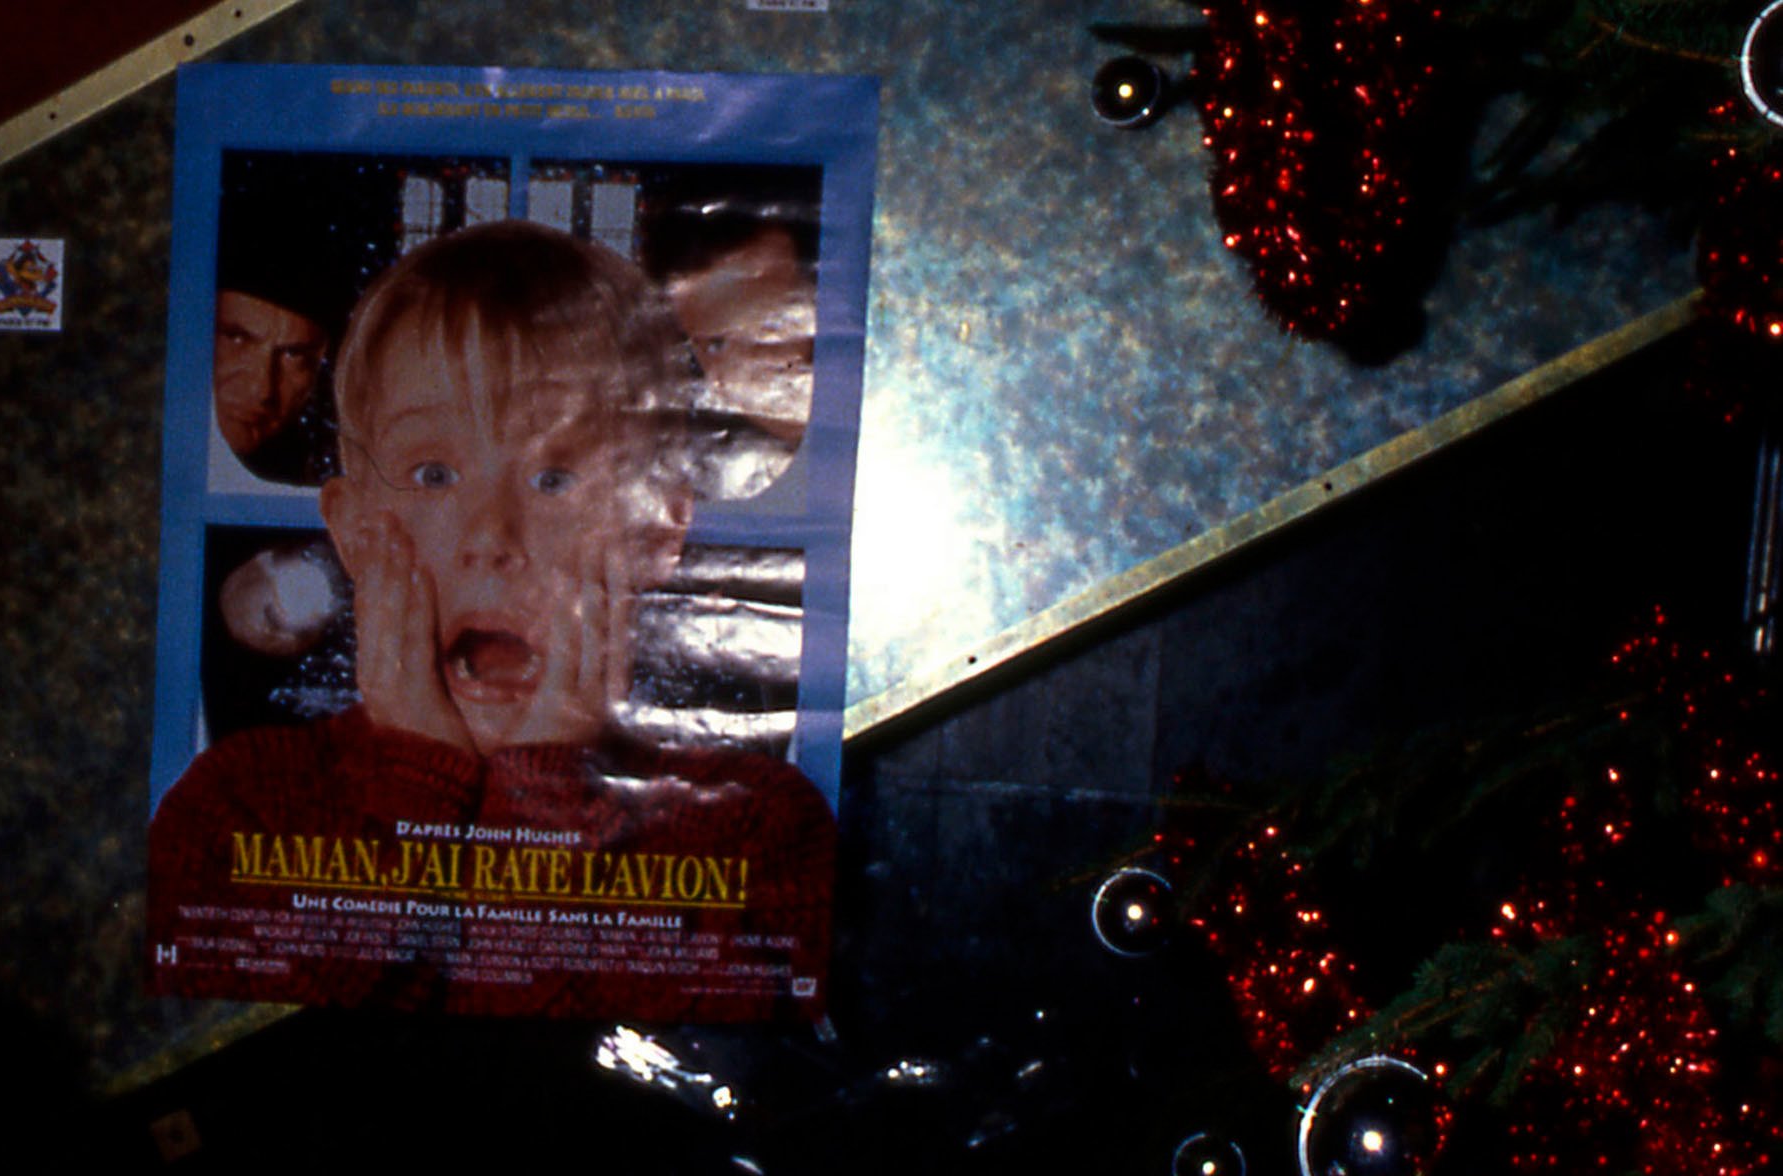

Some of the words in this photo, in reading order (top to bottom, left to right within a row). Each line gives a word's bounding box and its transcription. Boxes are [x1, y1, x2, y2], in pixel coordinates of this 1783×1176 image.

[465, 823, 512, 842] JOHN
[516, 826, 581, 845] HUGHES
[230, 831, 388, 886] MAMAN,
[391, 840, 462, 888] J'AI
[473, 842, 571, 895] RATÉ
[292, 892, 328, 910] UNE
[406, 899, 450, 918] POUR
[455, 904, 474, 919] LA
[477, 904, 542, 924] FAMILLE
[549, 908, 589, 924] SANS
[593, 911, 612, 926] LA
[616, 911, 682, 930] FAMILLE
